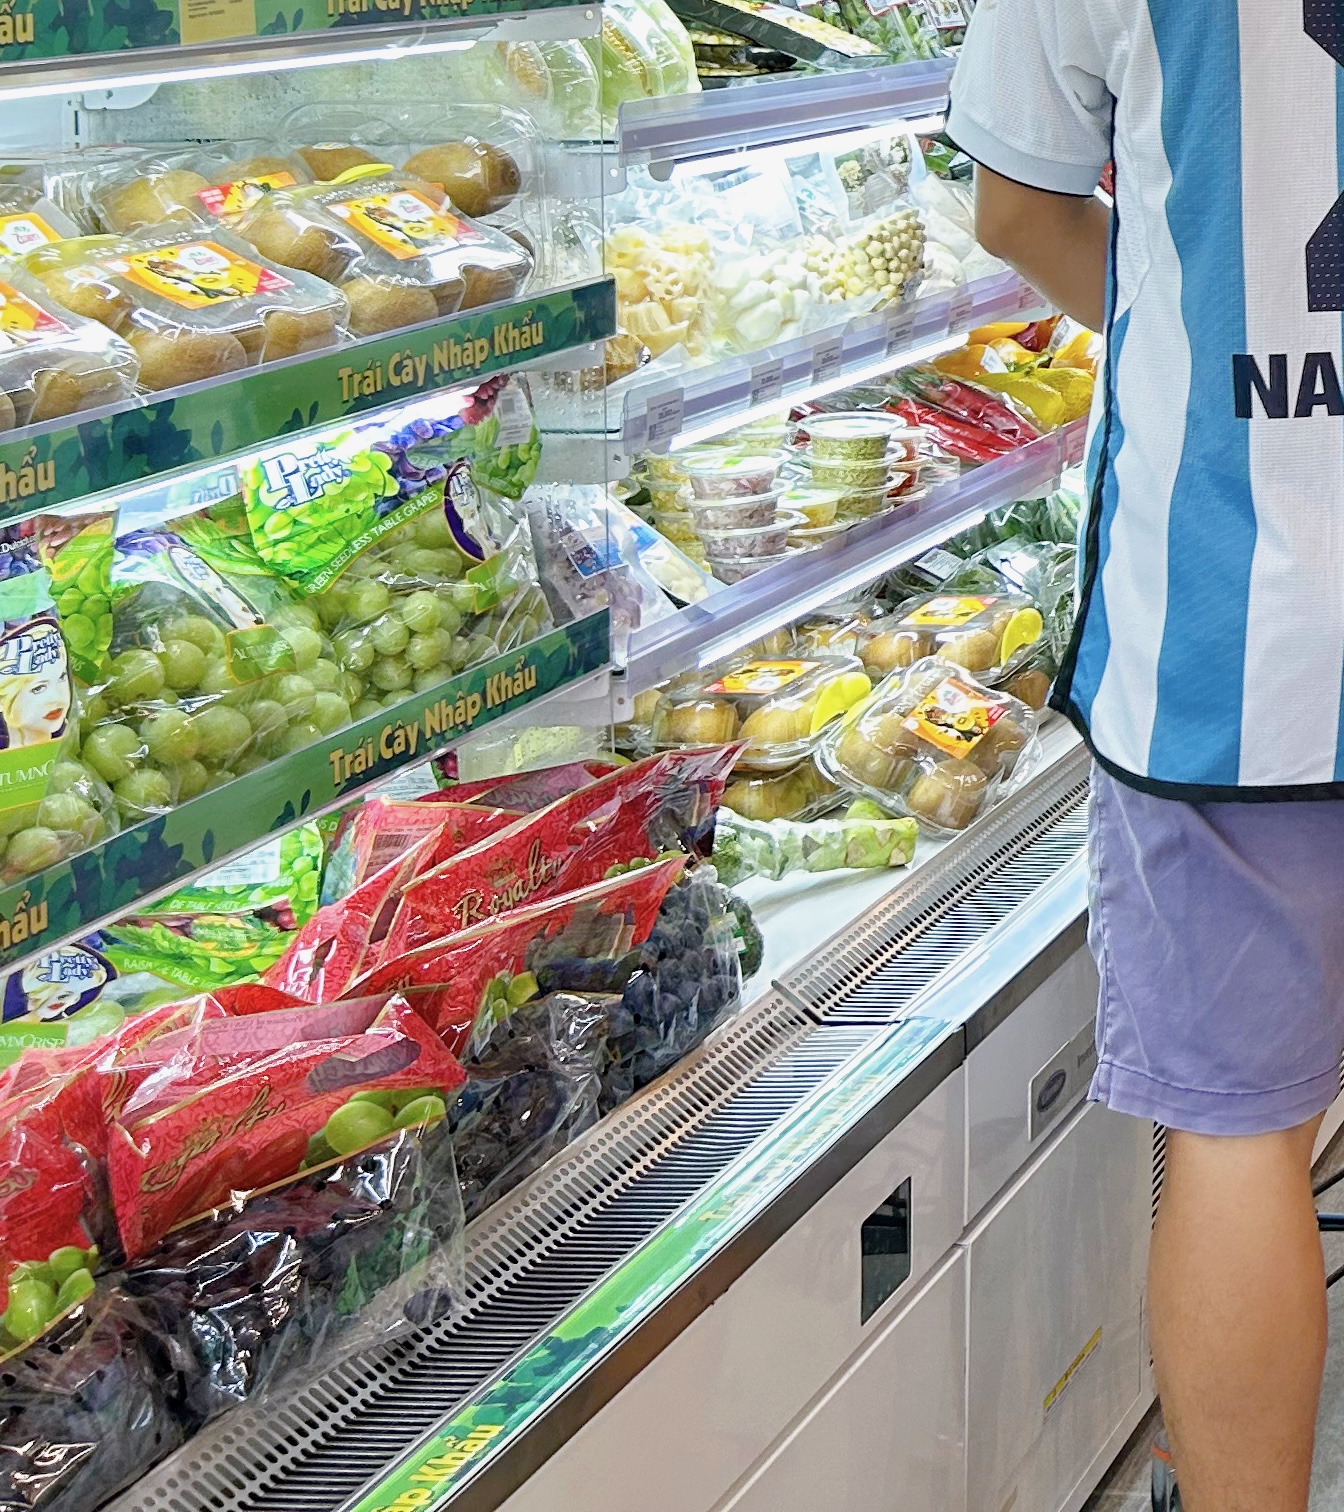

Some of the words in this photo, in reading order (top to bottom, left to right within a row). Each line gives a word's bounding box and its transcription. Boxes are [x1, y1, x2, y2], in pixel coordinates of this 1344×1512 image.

[338, 361, 382, 404] Trái
[387, 350, 427, 392] Cây
[433, 330, 488, 377] Nhập
[494, 310, 545, 364] Khẩu
[370, 512, 406, 538] TABLE
[403, 489, 440, 518] GRAPES
[329, 743, 375, 787] Trái
[378, 720, 419, 762] Cây
[423, 691, 482, 740] Nhập
[485, 654, 537, 708] Khẩu
[408, 1424, 506, 1484] Khẩu
